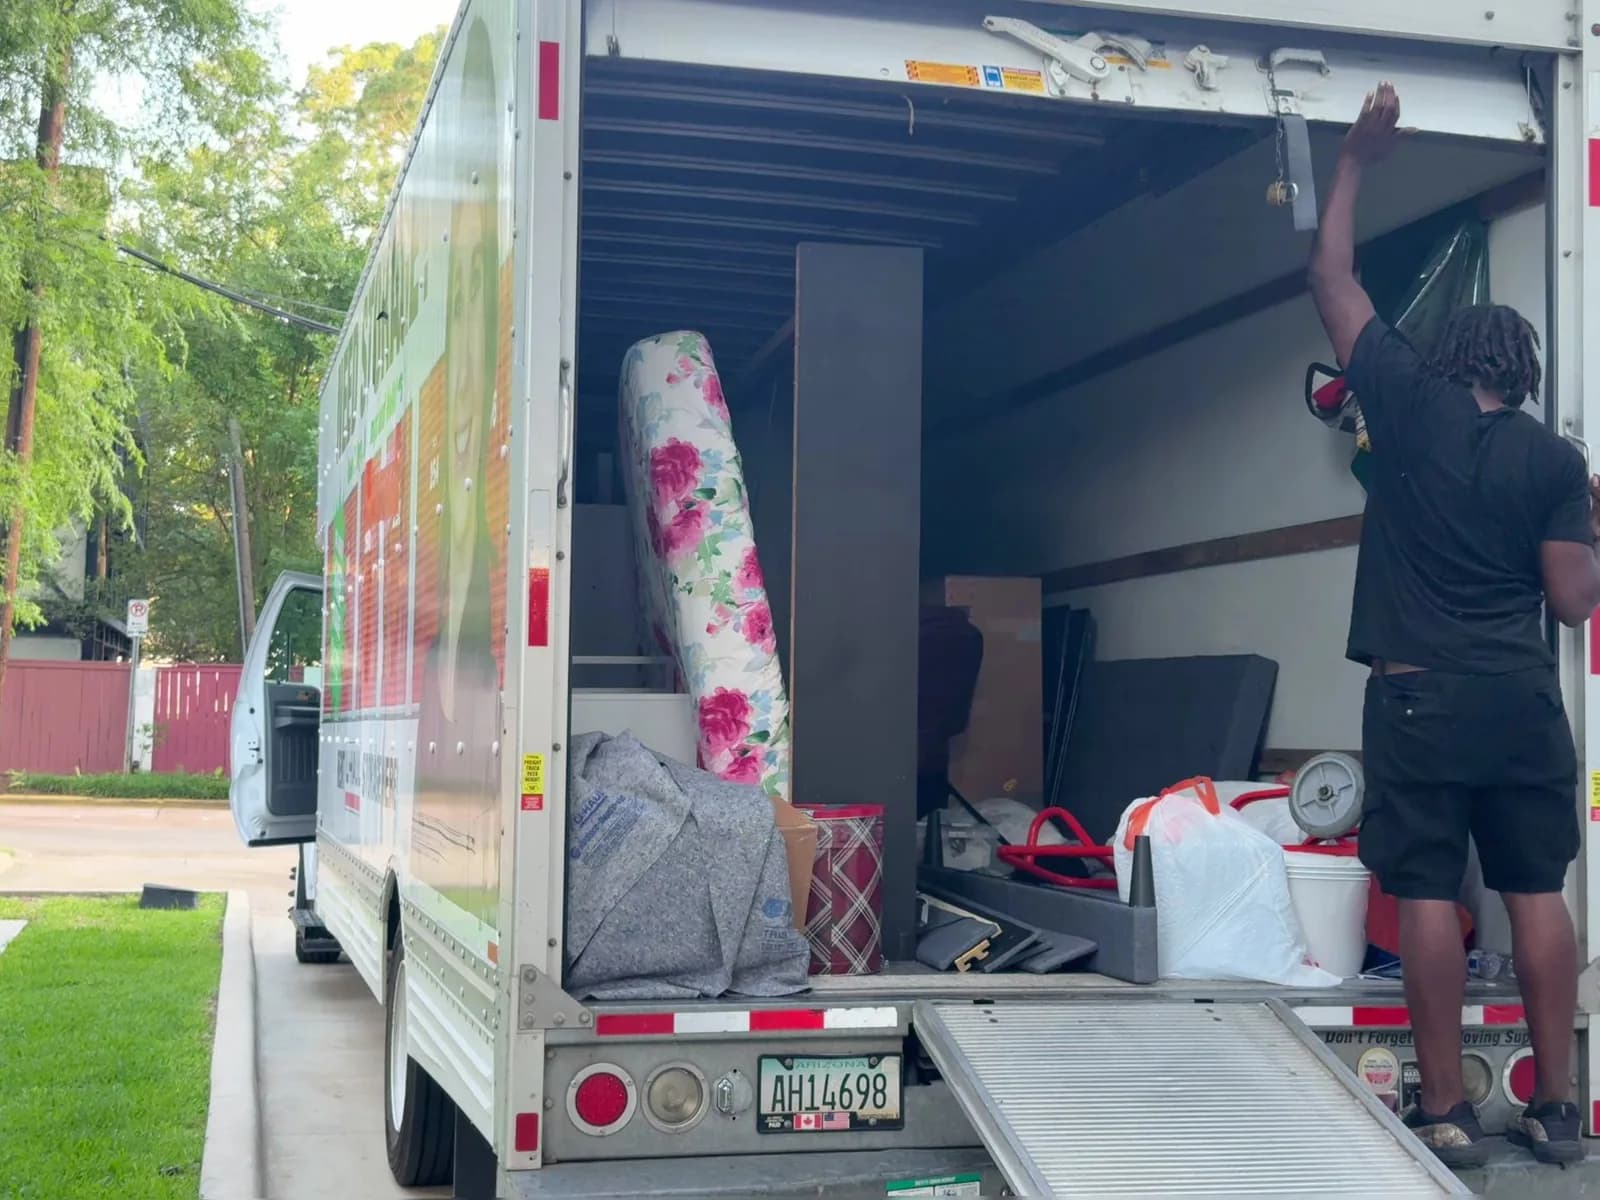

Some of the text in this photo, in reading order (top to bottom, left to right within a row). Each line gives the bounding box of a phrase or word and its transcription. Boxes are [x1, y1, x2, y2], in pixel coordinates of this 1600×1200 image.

[1325, 1030, 1364, 1044] Don't
[1367, 1030, 1413, 1047] Forget
[1461, 1030, 1501, 1047] oving
[795, 1059, 867, 1069] ARIZONA
[771, 1073, 888, 1112] AH14698
